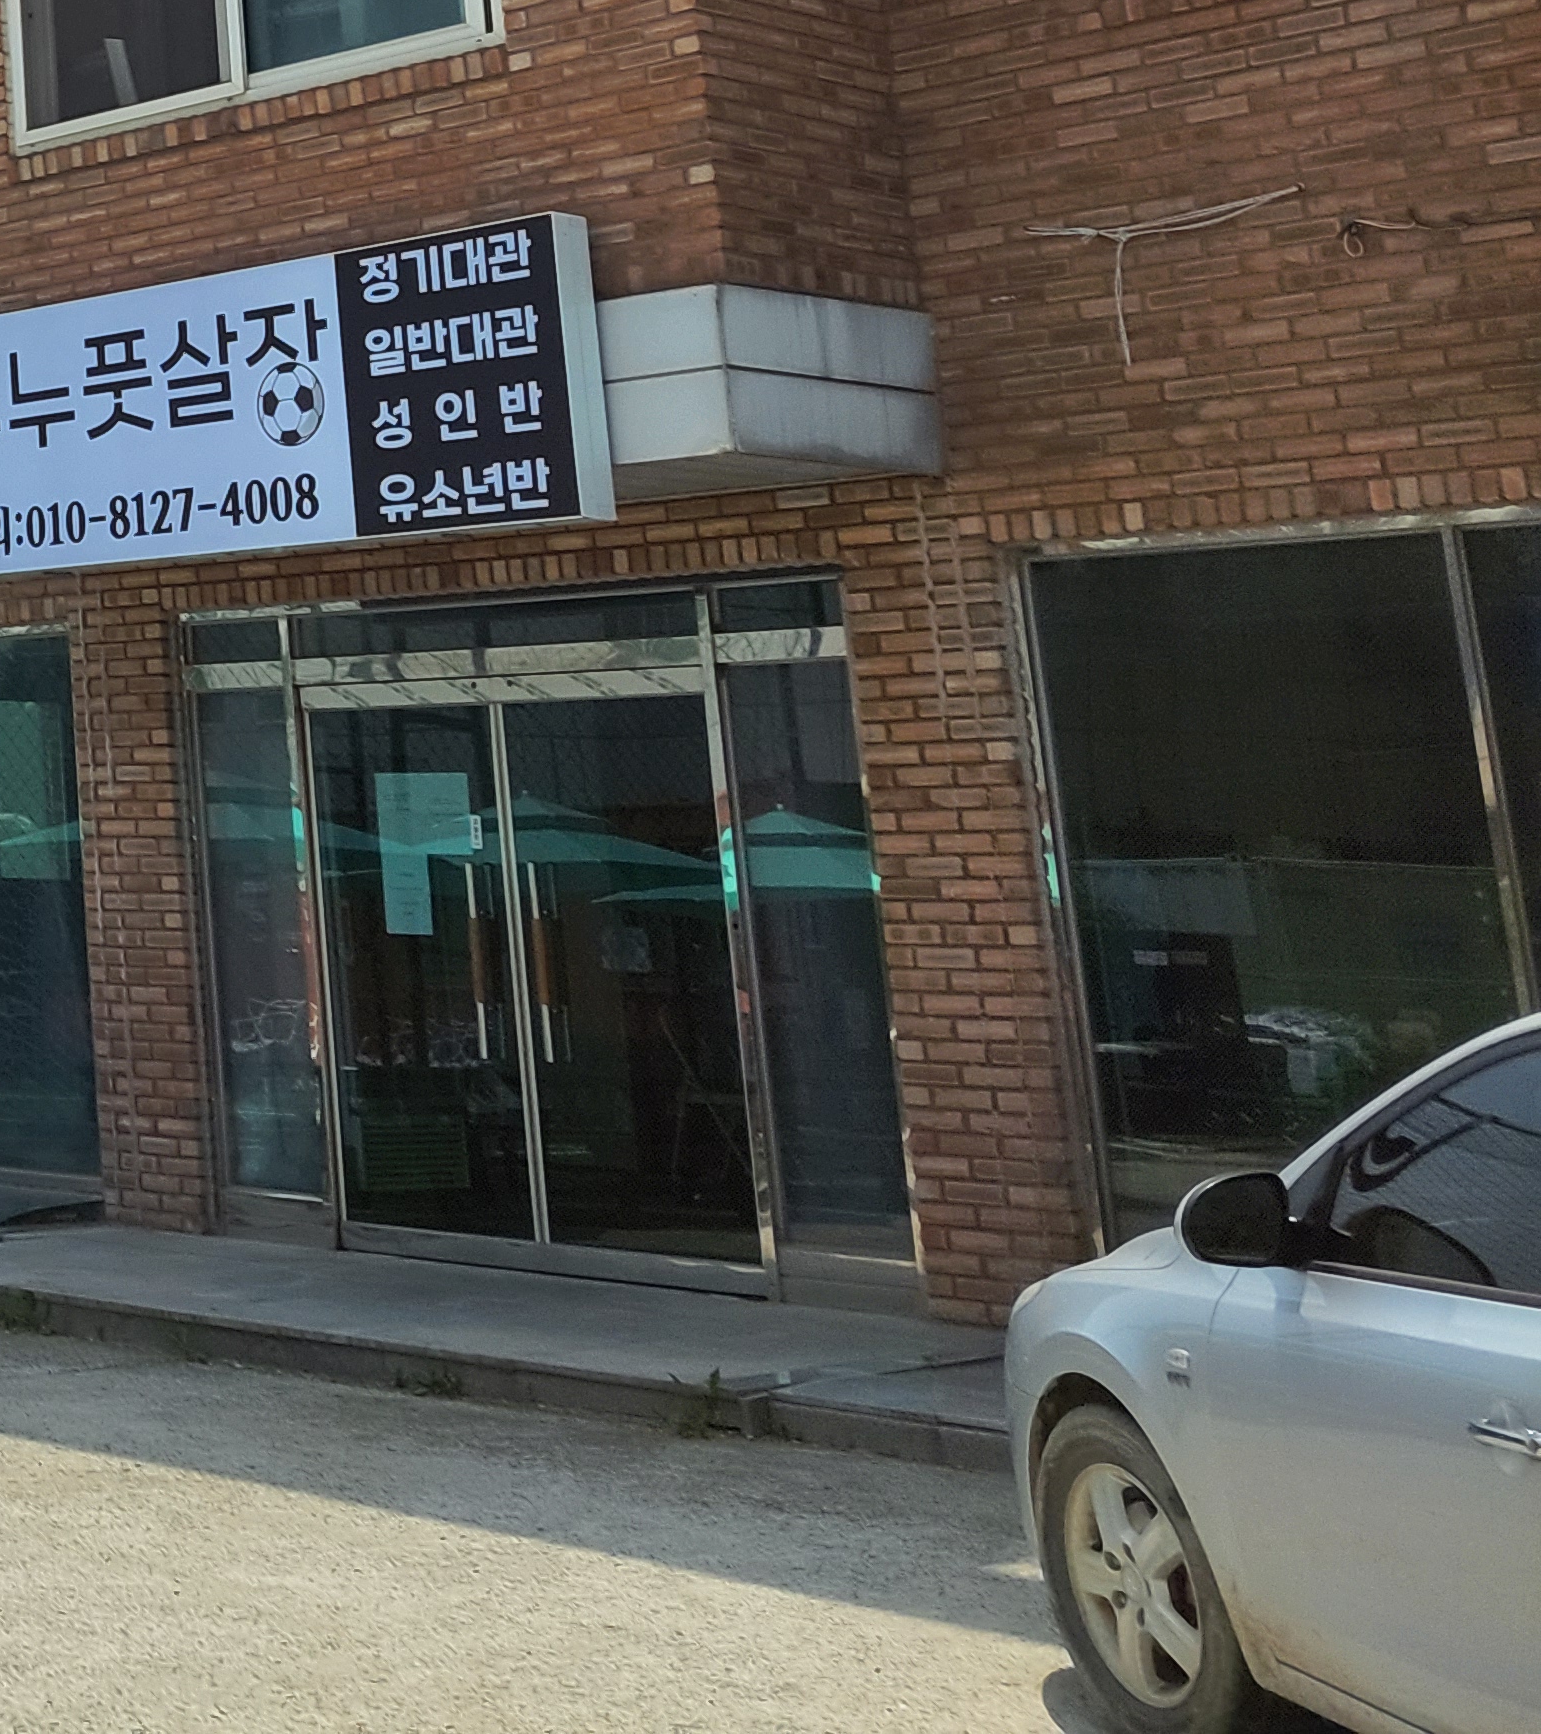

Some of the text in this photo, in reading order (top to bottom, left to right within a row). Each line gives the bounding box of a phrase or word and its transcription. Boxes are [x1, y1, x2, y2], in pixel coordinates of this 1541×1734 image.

[358, 228, 532, 304] 정기대관
[363, 305, 539, 377] 일반대관
[378, 457, 552, 523] 유소년반
